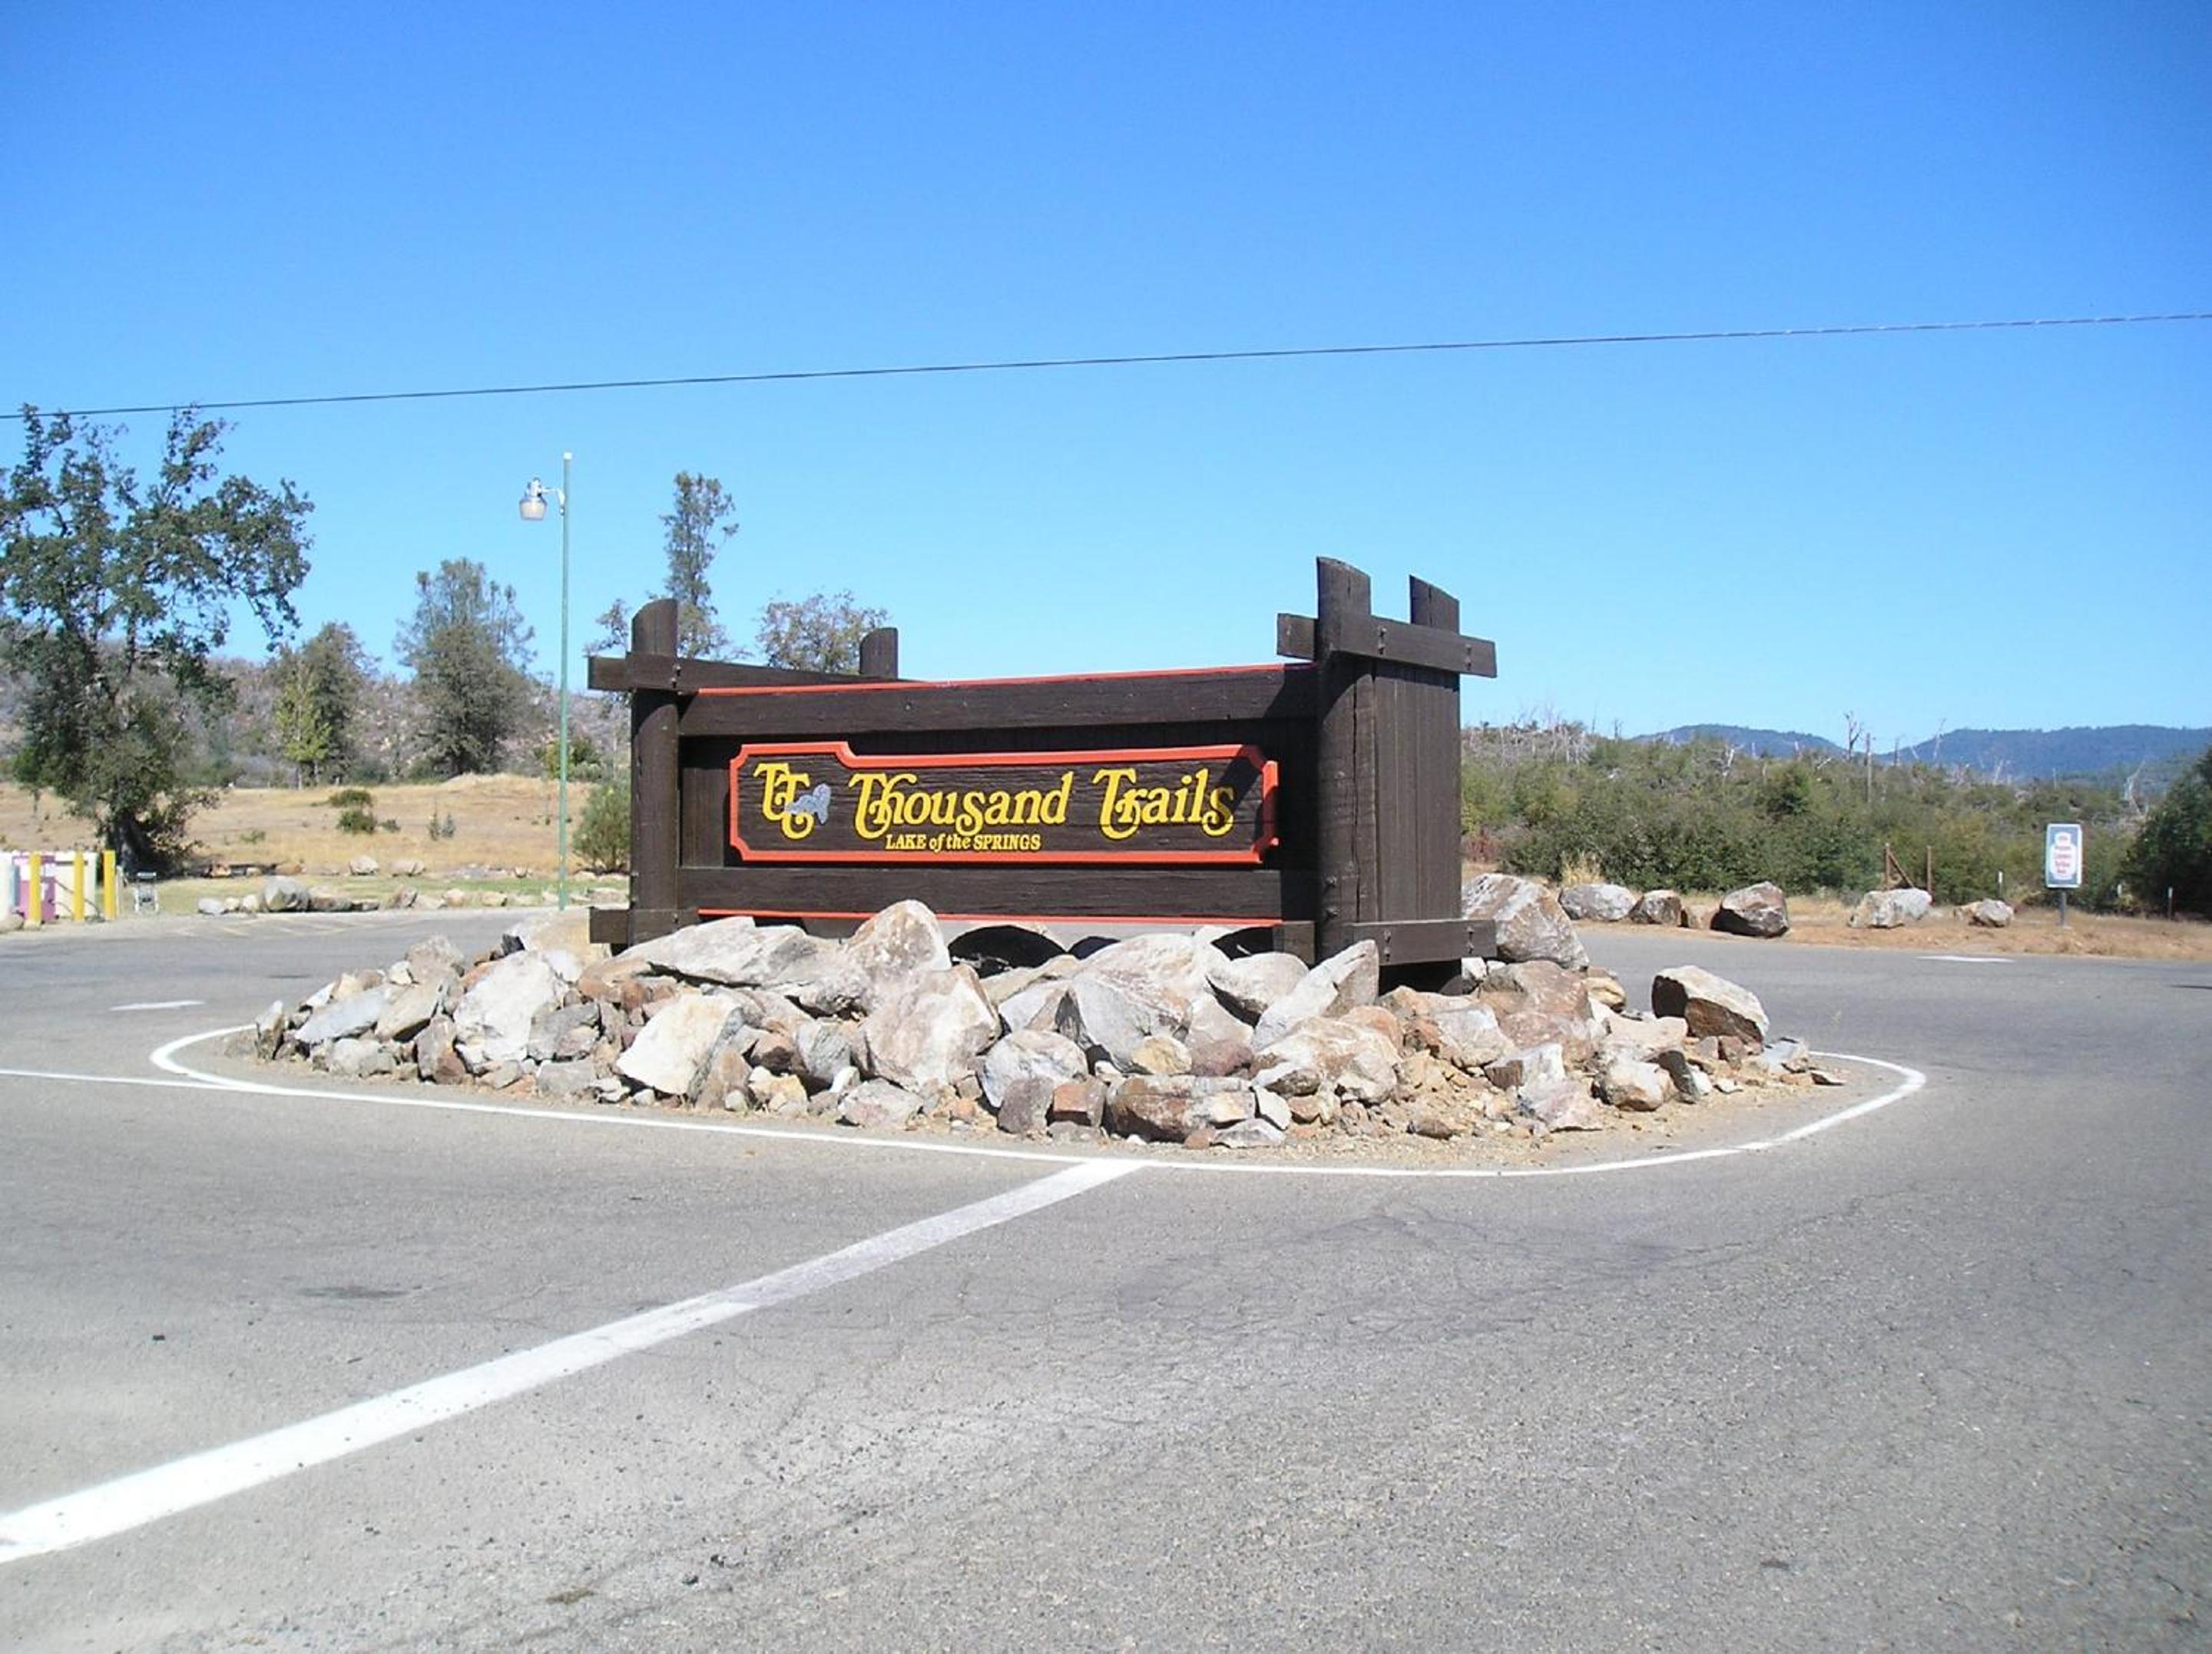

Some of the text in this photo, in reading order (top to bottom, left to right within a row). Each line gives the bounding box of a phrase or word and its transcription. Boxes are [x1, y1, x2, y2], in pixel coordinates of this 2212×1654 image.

[848, 768, 1234, 839] Thousand Trails
[885, 833, 1041, 852] LAKE of the SPRINGS
